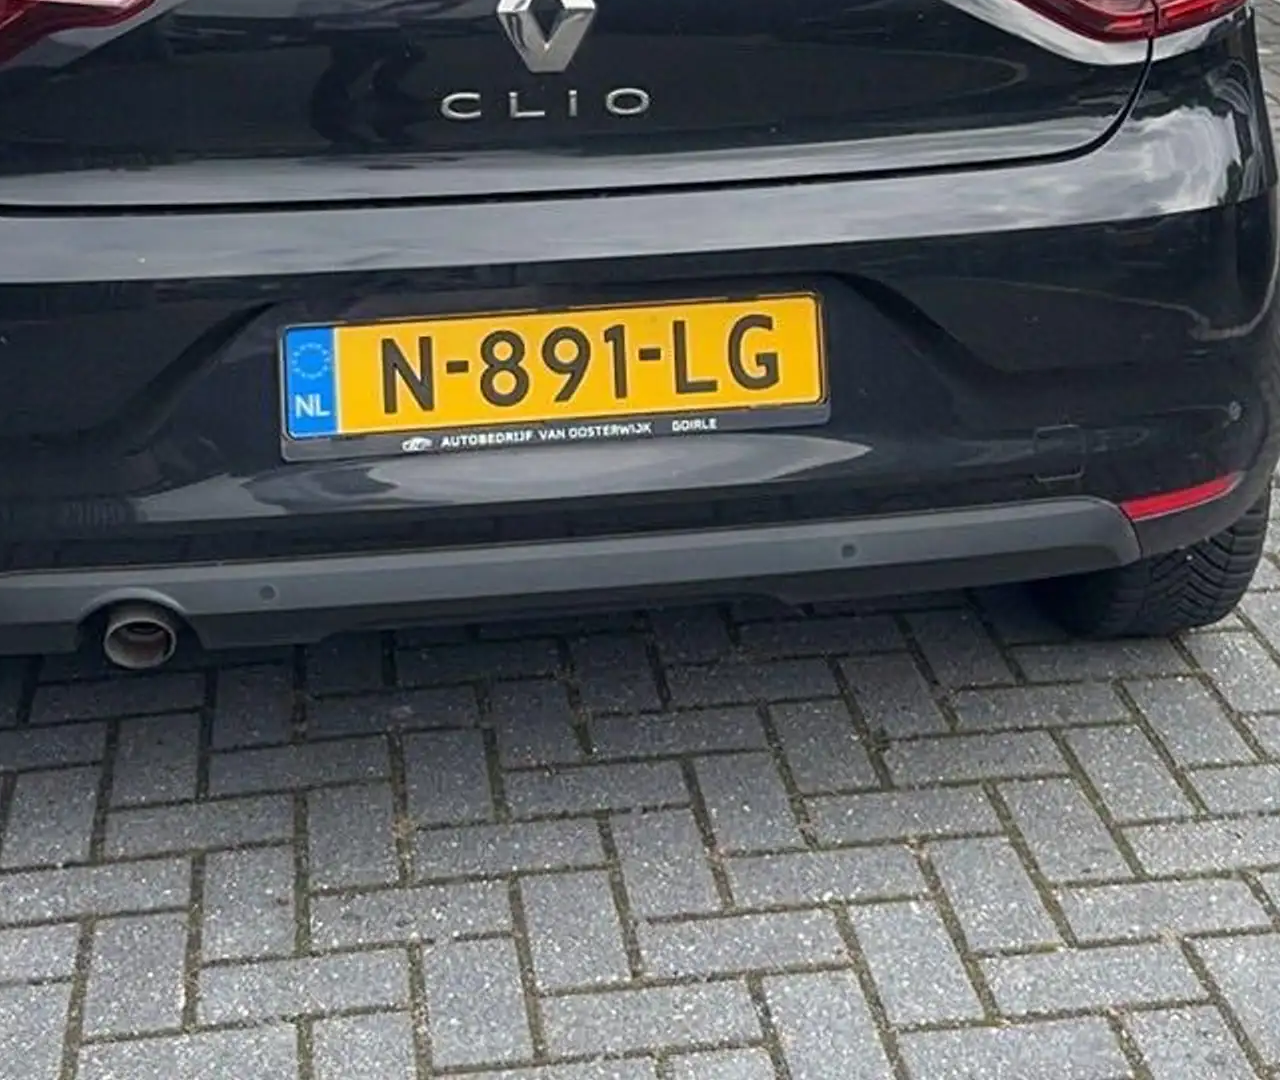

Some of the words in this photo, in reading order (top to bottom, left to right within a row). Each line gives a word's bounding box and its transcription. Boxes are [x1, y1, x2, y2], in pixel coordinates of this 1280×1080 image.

[381, 313, 781, 416] N-891-LG
[295, 394, 330, 418] NL
[440, 430, 533, 448] AUTOBEDRIJF
[538, 427, 565, 441] VAN
[568, 422, 653, 439] OOSTERWIJK
